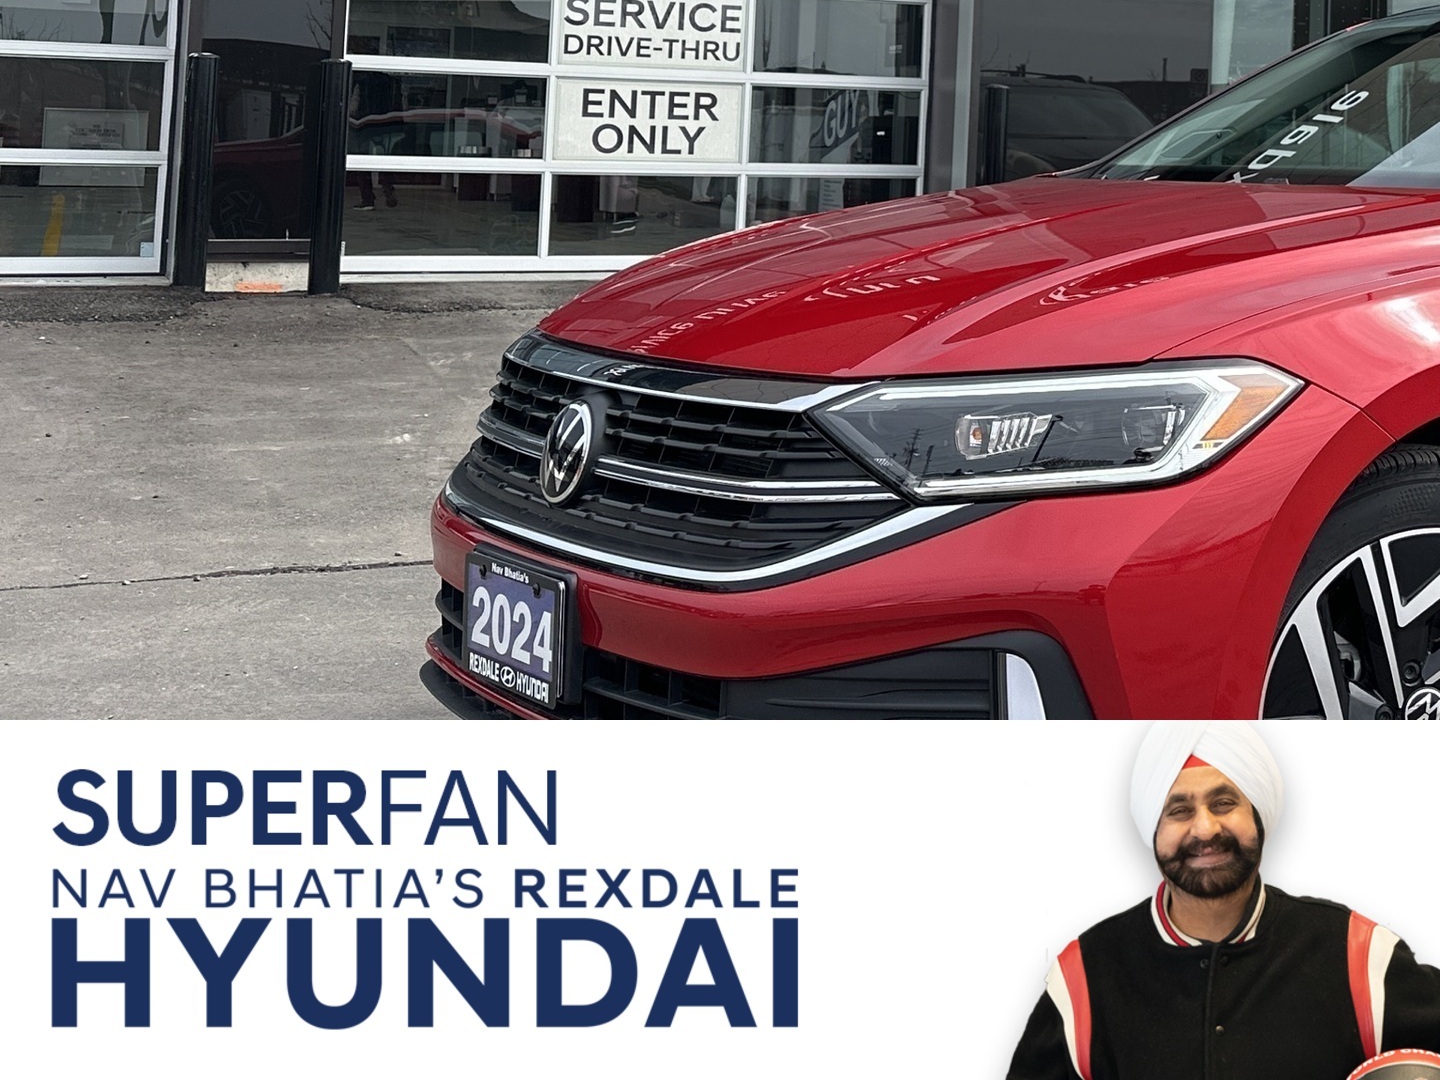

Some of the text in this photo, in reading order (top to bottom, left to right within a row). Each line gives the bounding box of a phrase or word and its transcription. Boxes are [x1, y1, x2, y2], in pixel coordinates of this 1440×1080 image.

[563, 34, 741, 62] DRIVE-THRU
[581, 88, 719, 121] ENTER
[824, 90, 860, 152] GUY
[592, 123, 706, 155] ONLY
[491, 562, 529, 584] Nav Bhatia's
[471, 586, 552, 674] 2024
[469, 651, 549, 704] REXDALE HYUNDAI
